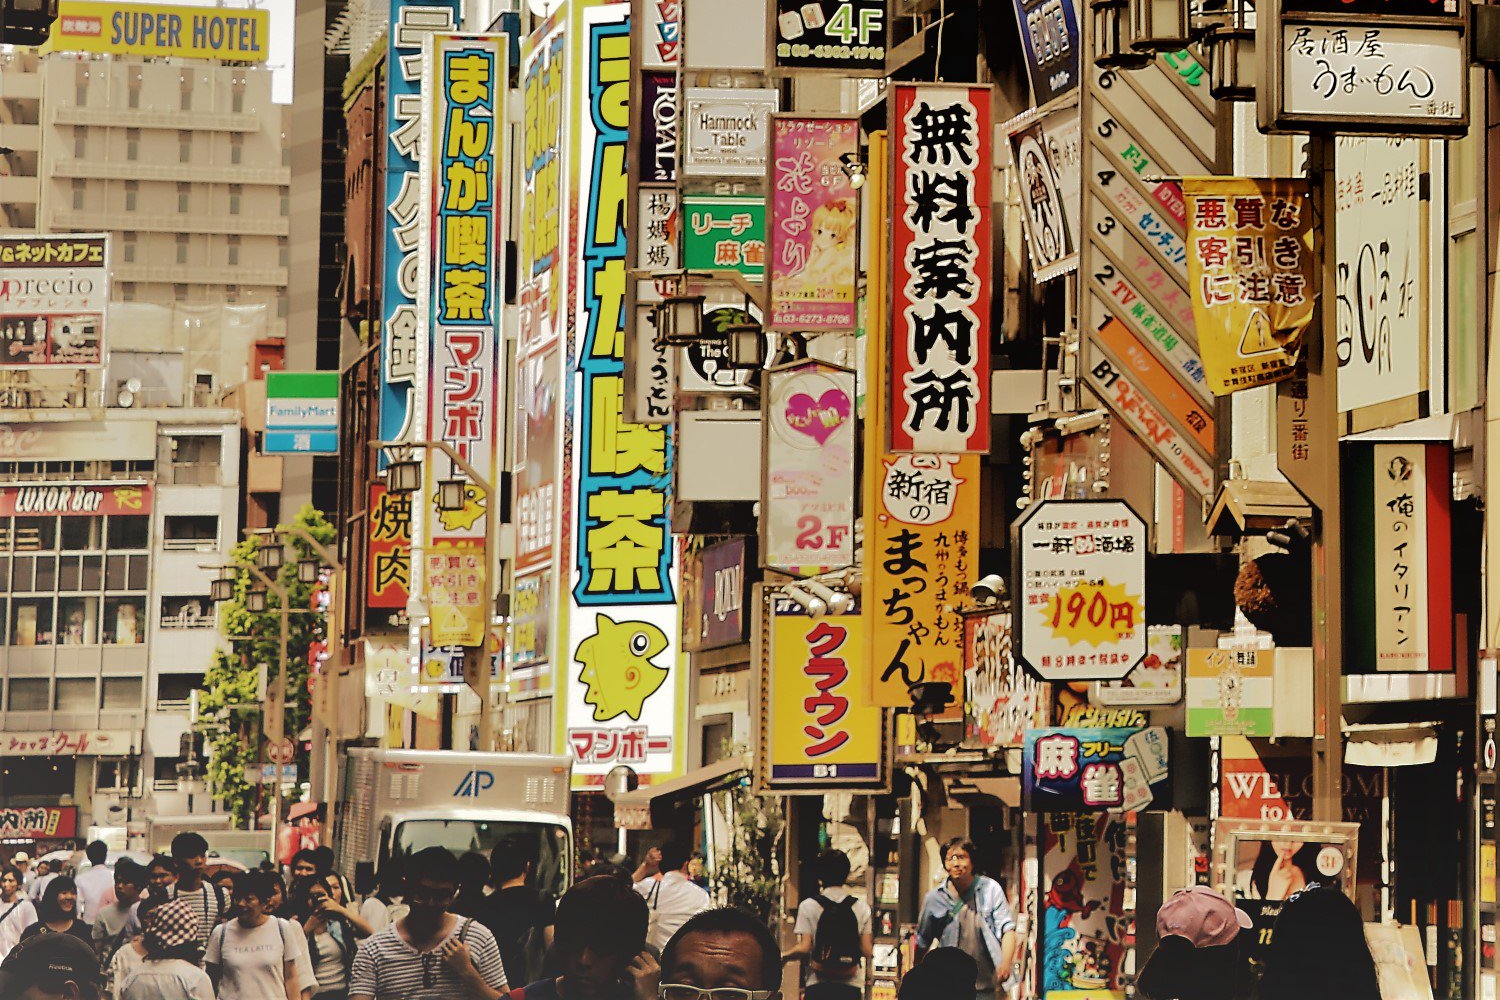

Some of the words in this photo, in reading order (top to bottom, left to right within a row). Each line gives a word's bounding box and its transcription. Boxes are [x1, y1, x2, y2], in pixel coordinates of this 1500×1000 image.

[112, 11, 182, 48] SUPER
[193, 14, 260, 52] HOTEL
[824, 3, 884, 44] 4F
[1288, 28, 1386, 59] 居酒屋
[1098, 70, 1118, 89] 6
[1313, 59, 1435, 100] うまいもん
[699, 114, 758, 131] Hammock
[1409, 101, 1457, 117] 一番街
[712, 133, 747, 147] Table
[1097, 118, 1119, 138] 5
[444, 50, 492, 322] まんが喫茶
[715, 183, 746, 194] 2F
[1097, 169, 1116, 186] 4
[691, 212, 754, 235] リーチ
[1097, 216, 1116, 236] 3
[1196, 196, 1301, 230] 悪質な
[715, 240, 765, 266] 麻雀
[1138, 212, 1188, 265] センチュリ
[1198, 236, 1302, 268] 客引き
[904, 101, 978, 435] 無料案内所
[1094, 264, 1115, 286] 2
[1111, 280, 1137, 306] TV
[1202, 274, 1306, 307] に注意
[1097, 313, 1114, 332] 1
[1091, 359, 1120, 388] B1
[269, 405, 336, 419] FamilyMart
[14, 485, 72, 513] LUXOR
[887, 470, 951, 505] 新宿
[910, 504, 931, 522] の
[372, 497, 412, 593] 焼肉
[796, 514, 849, 550] 2F
[1386, 492, 1415, 645] 俺のイタリアン
[881, 529, 932, 685] まっちゃん
[1052, 590, 1135, 629] 190円
[803, 622, 849, 757] クラウン
[569, 727, 671, 762] マンボー
[1082, 741, 1125, 757] フリー
[812, 766, 838, 778] B1
[1260, 803, 1284, 821] to
